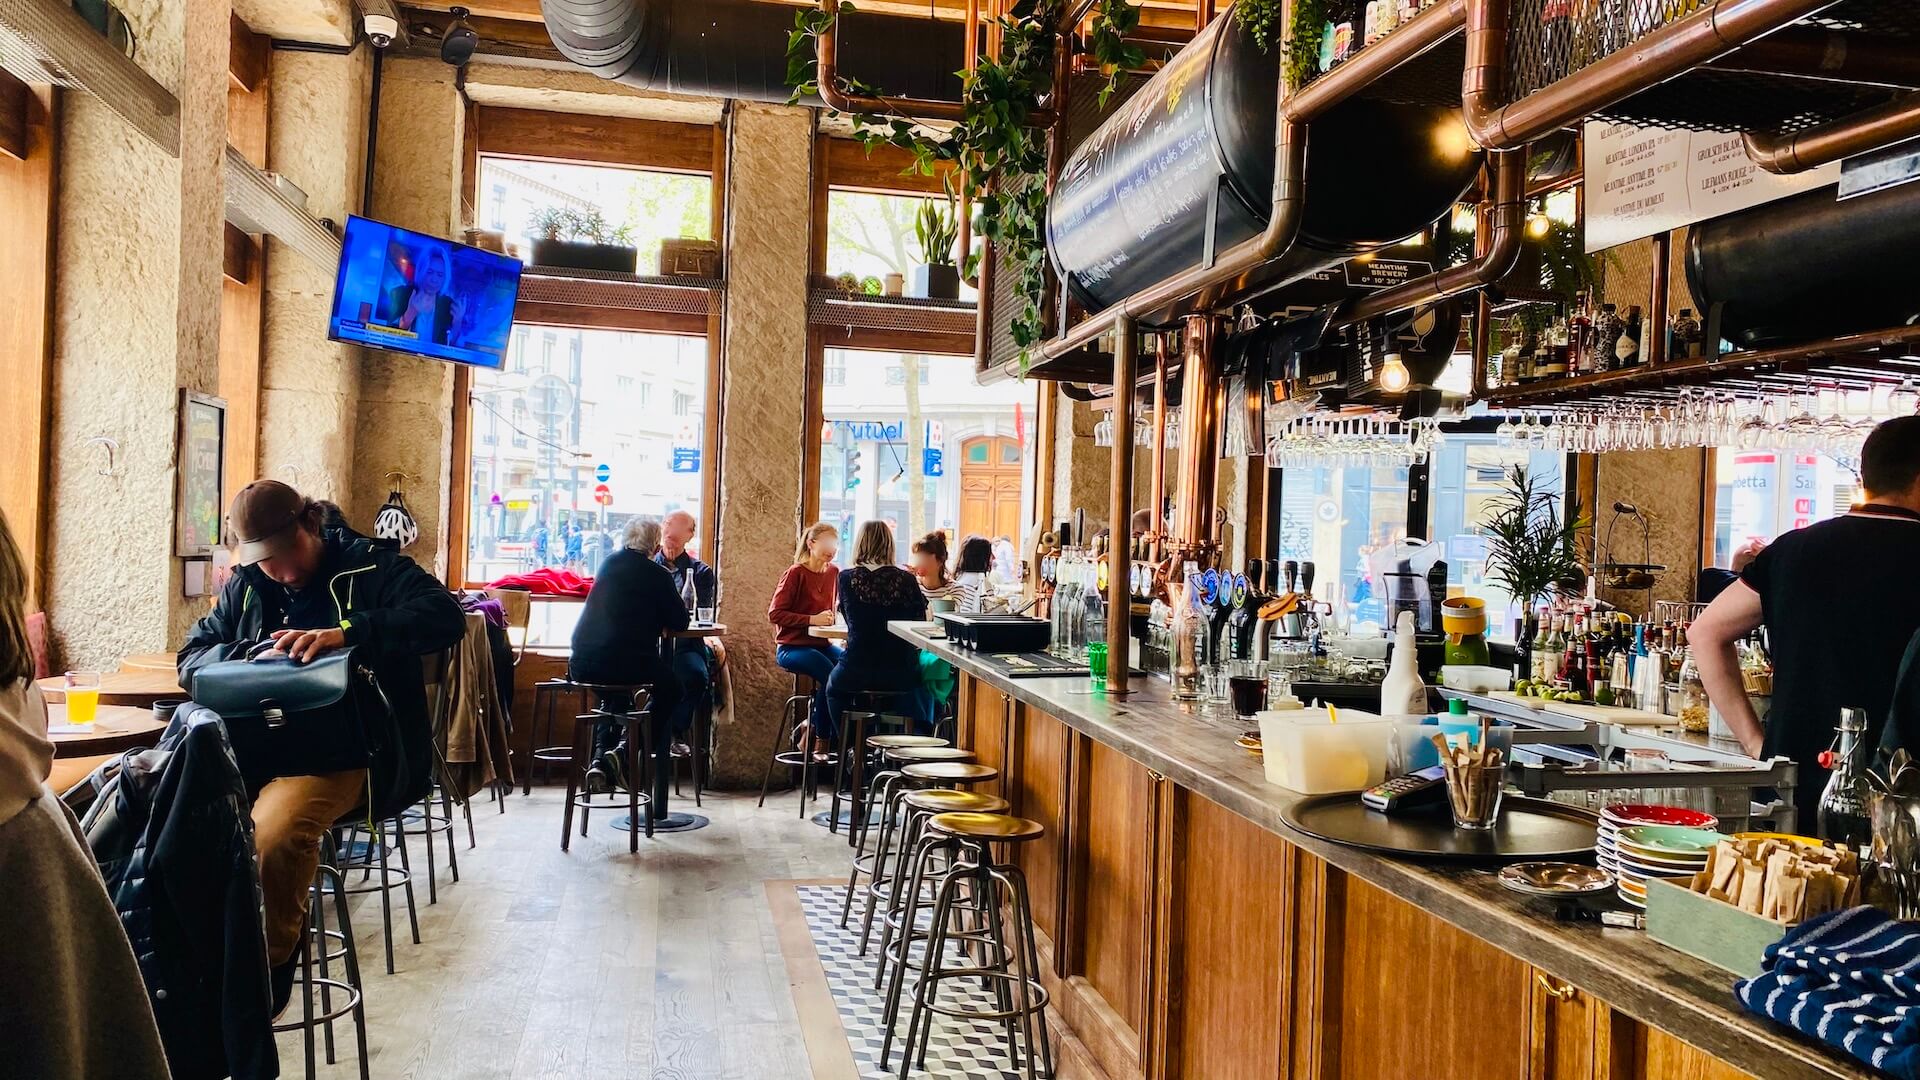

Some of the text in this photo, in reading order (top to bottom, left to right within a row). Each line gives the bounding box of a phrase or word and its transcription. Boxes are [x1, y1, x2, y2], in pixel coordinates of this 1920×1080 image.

[1606, 148, 1626, 165] MEANTIME
[1628, 141, 1648, 158] LONDON
[1697, 145, 1723, 161] GROLSCH
[1603, 176, 1626, 193] MEANTIME
[1626, 170, 1647, 187] ANYTIME
[1701, 174, 1728, 190] LIEFMANS
[1727, 166, 1748, 181] ROUGE
[1645, 192, 1665, 208] MOMENT
[1368, 263, 1409, 271] MEANTIME
[1371, 270, 1408, 278] BREWERY
[1306, 273, 1330, 281] ILES
[1307, 371, 1337, 385] MEANTIME
[835, 420, 903, 439] utuel
